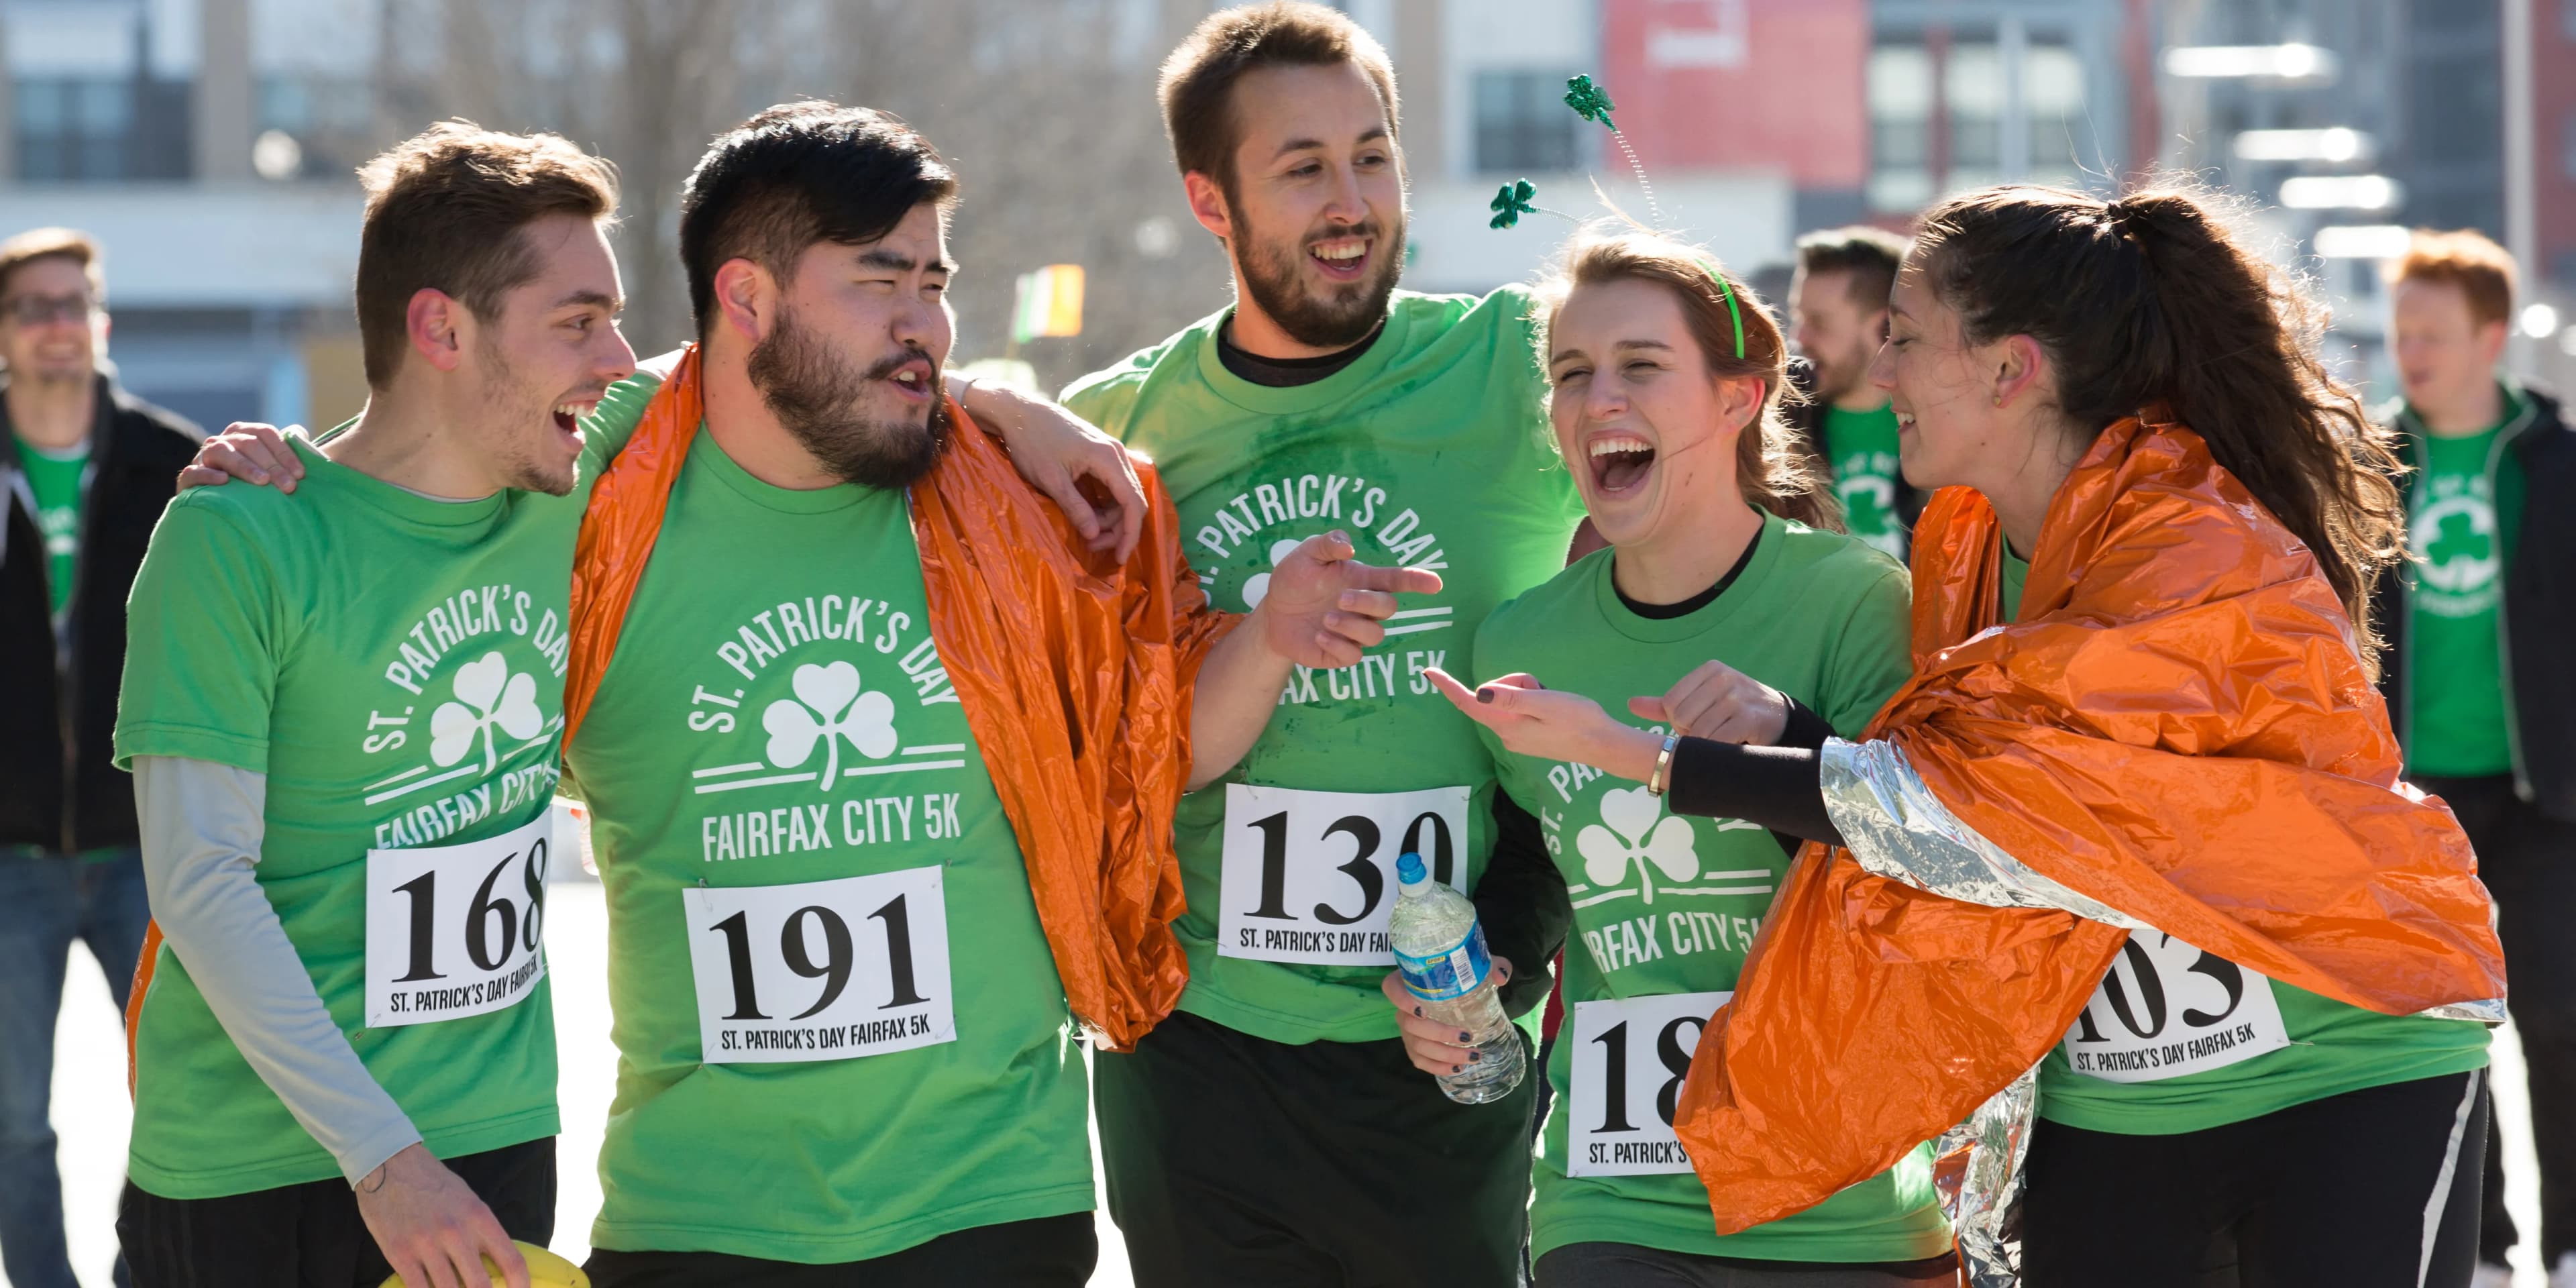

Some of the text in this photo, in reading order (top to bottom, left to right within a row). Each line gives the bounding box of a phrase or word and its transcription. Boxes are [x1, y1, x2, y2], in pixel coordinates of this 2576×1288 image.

[1196, 474, 1449, 570] PATRICK'S DAY
[385, 584, 530, 694] PATRICK'S
[688, 594, 961, 733] ST. PATRICK'S DAY
[1328, 653, 1395, 700] CITY
[364, 705, 413, 753] ST.
[374, 783, 492, 849] FAIRFAX
[702, 793, 961, 861] FAIRFAX CITY 5K
[391, 837, 547, 982] 168
[1667, 912, 1731, 955] CITY
[709, 893, 930, 1021] 191
[1240, 928, 1260, 948] ST.
[1265, 930, 1335, 953] PATRICK'S
[1340, 932, 1366, 953] DAY
[390, 992, 410, 1012] ST.
[416, 983, 483, 1011] PATRICK'S
[487, 975, 508, 1002] DAY
[721, 1014, 930, 1051] ST. PATRICK'S DAY FAIRFAX 5K
[2077, 1023, 2256, 1071] ST. PATRICK'S DAY FAIRFAX 5K
[1590, 1016, 1709, 1133] 18
[1589, 1141, 1687, 1163] ST. PATRICK'S
